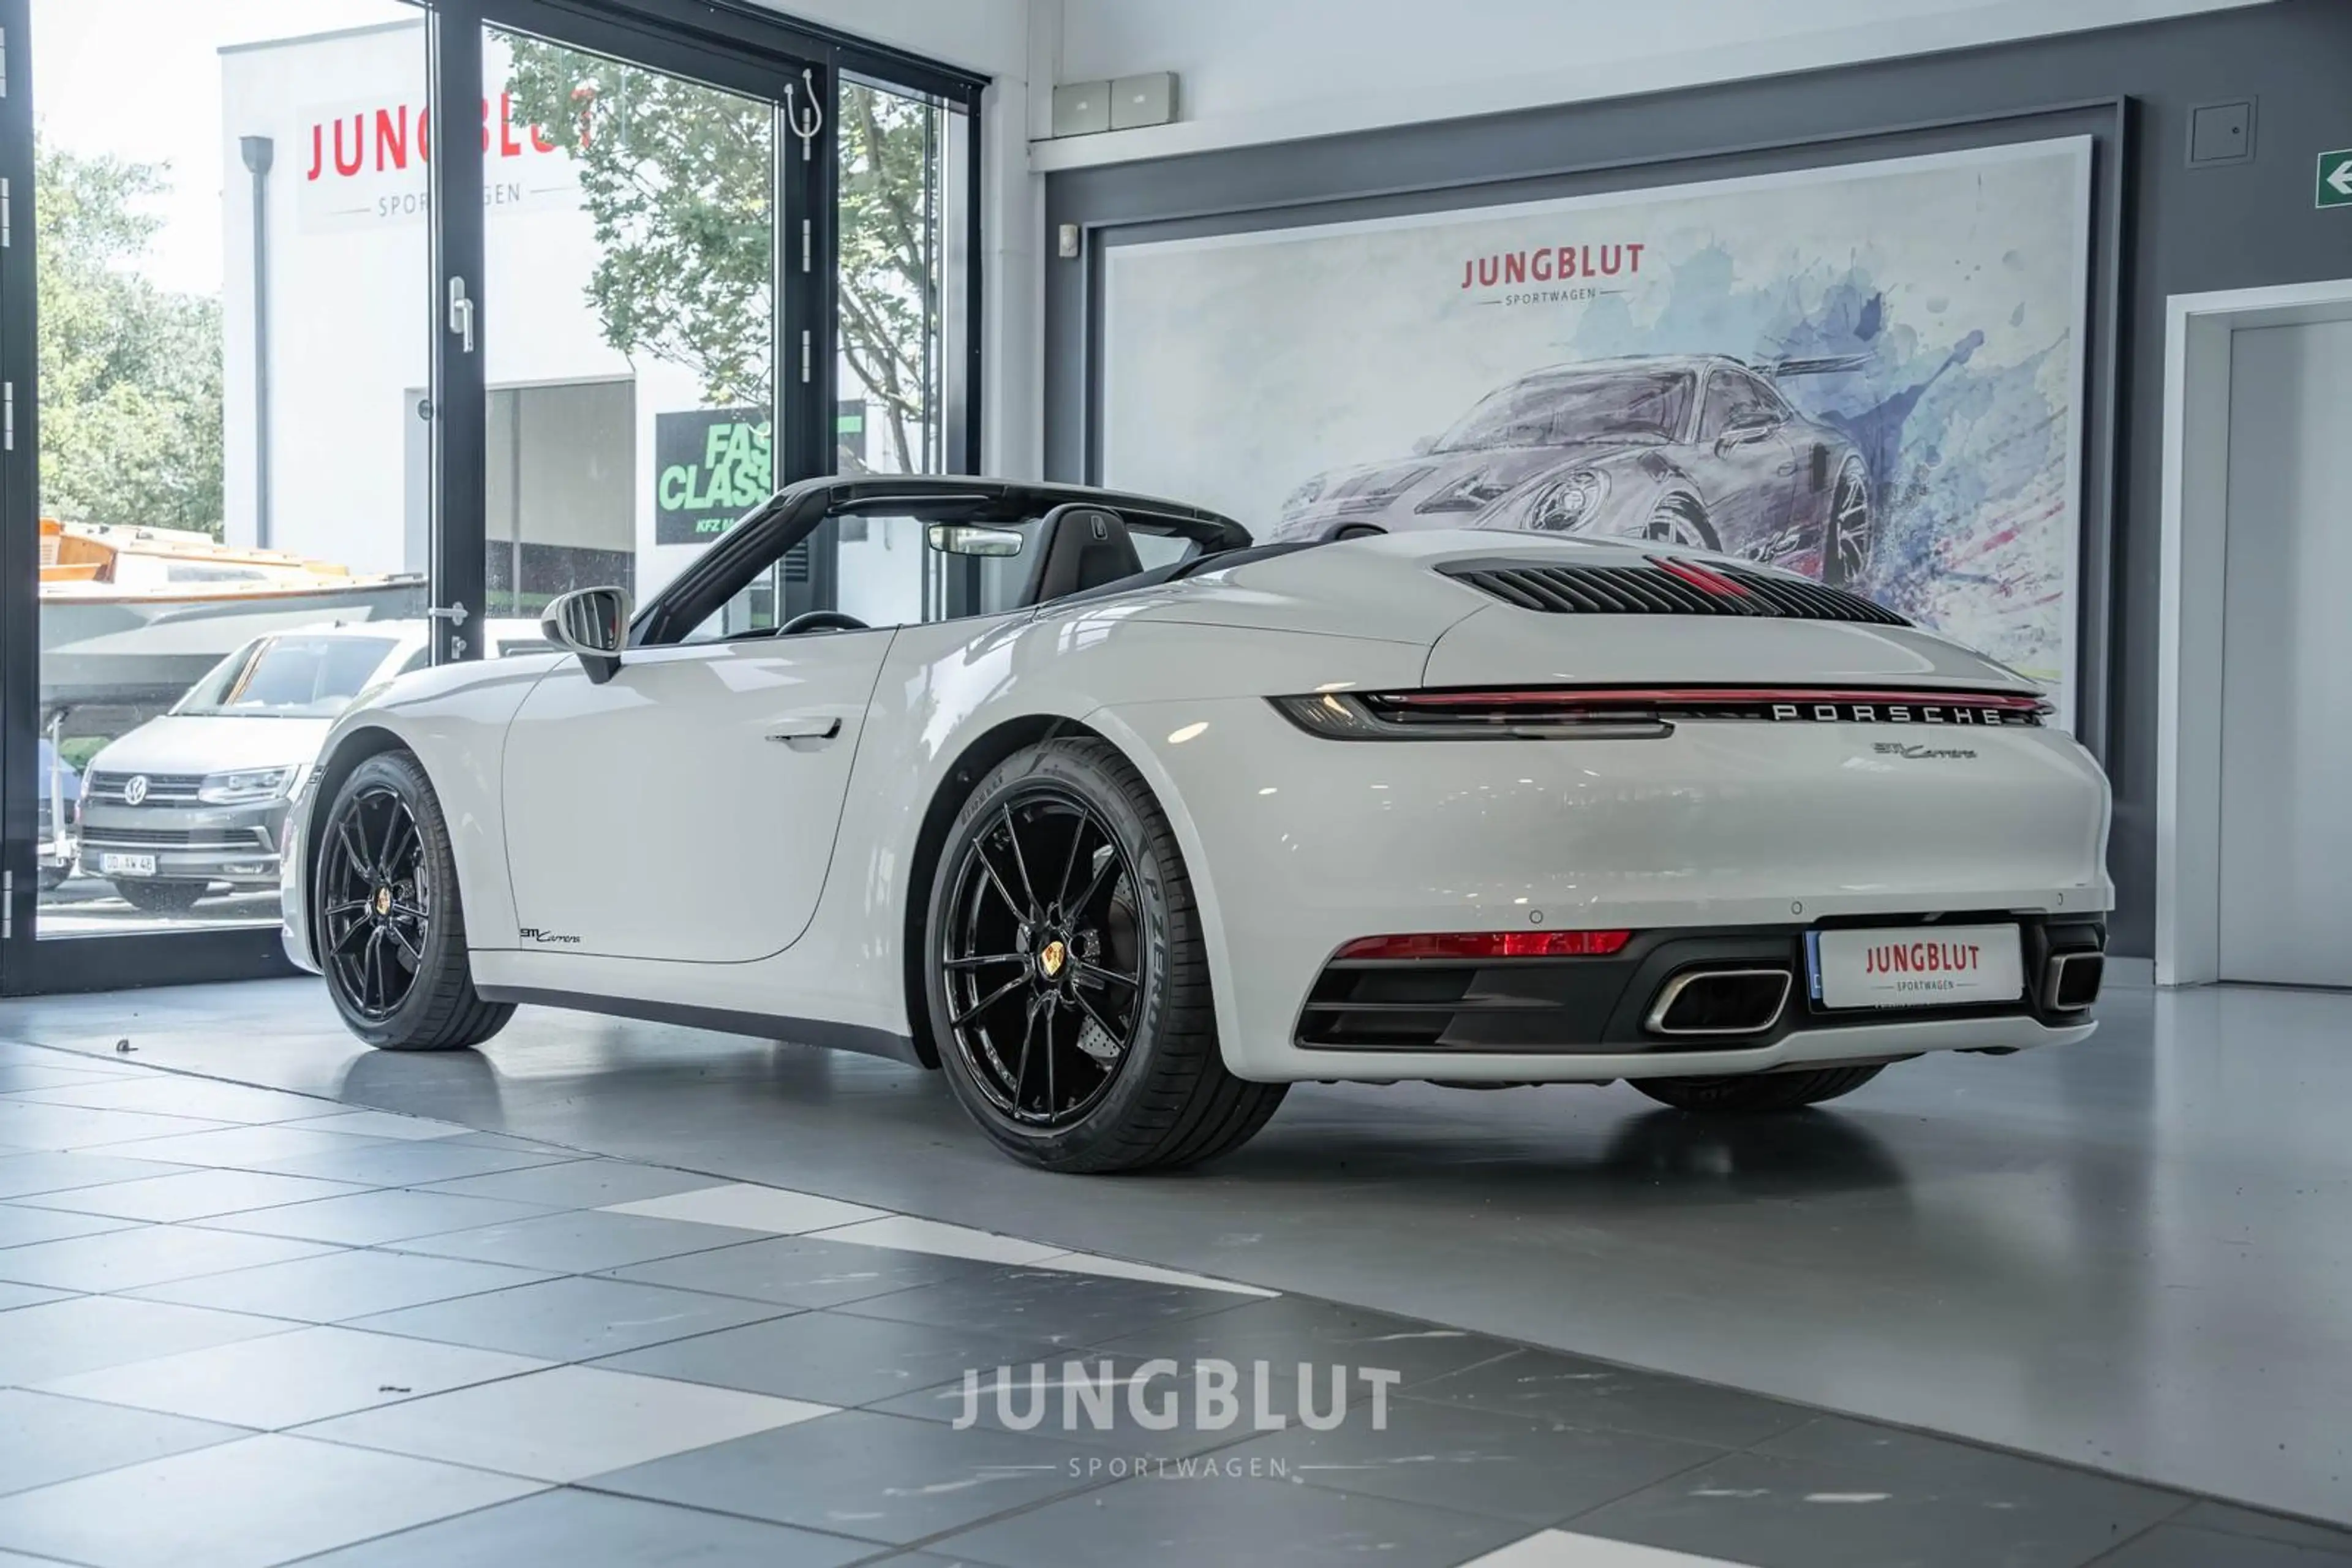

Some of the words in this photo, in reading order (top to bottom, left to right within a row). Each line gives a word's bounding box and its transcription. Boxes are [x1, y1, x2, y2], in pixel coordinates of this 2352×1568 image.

[379, 183, 520, 217] SPORGEN
[1461, 244, 1645, 288] JUNGBLUT
[1506, 288, 1596, 306] SPORTWAGEN
[695, 519, 721, 532] KFZ
[1772, 704, 2002, 725] PORSCHE
[1866, 943, 1980, 973] JUNGBLUT
[1896, 980, 1954, 991] SPORTWAGEN
